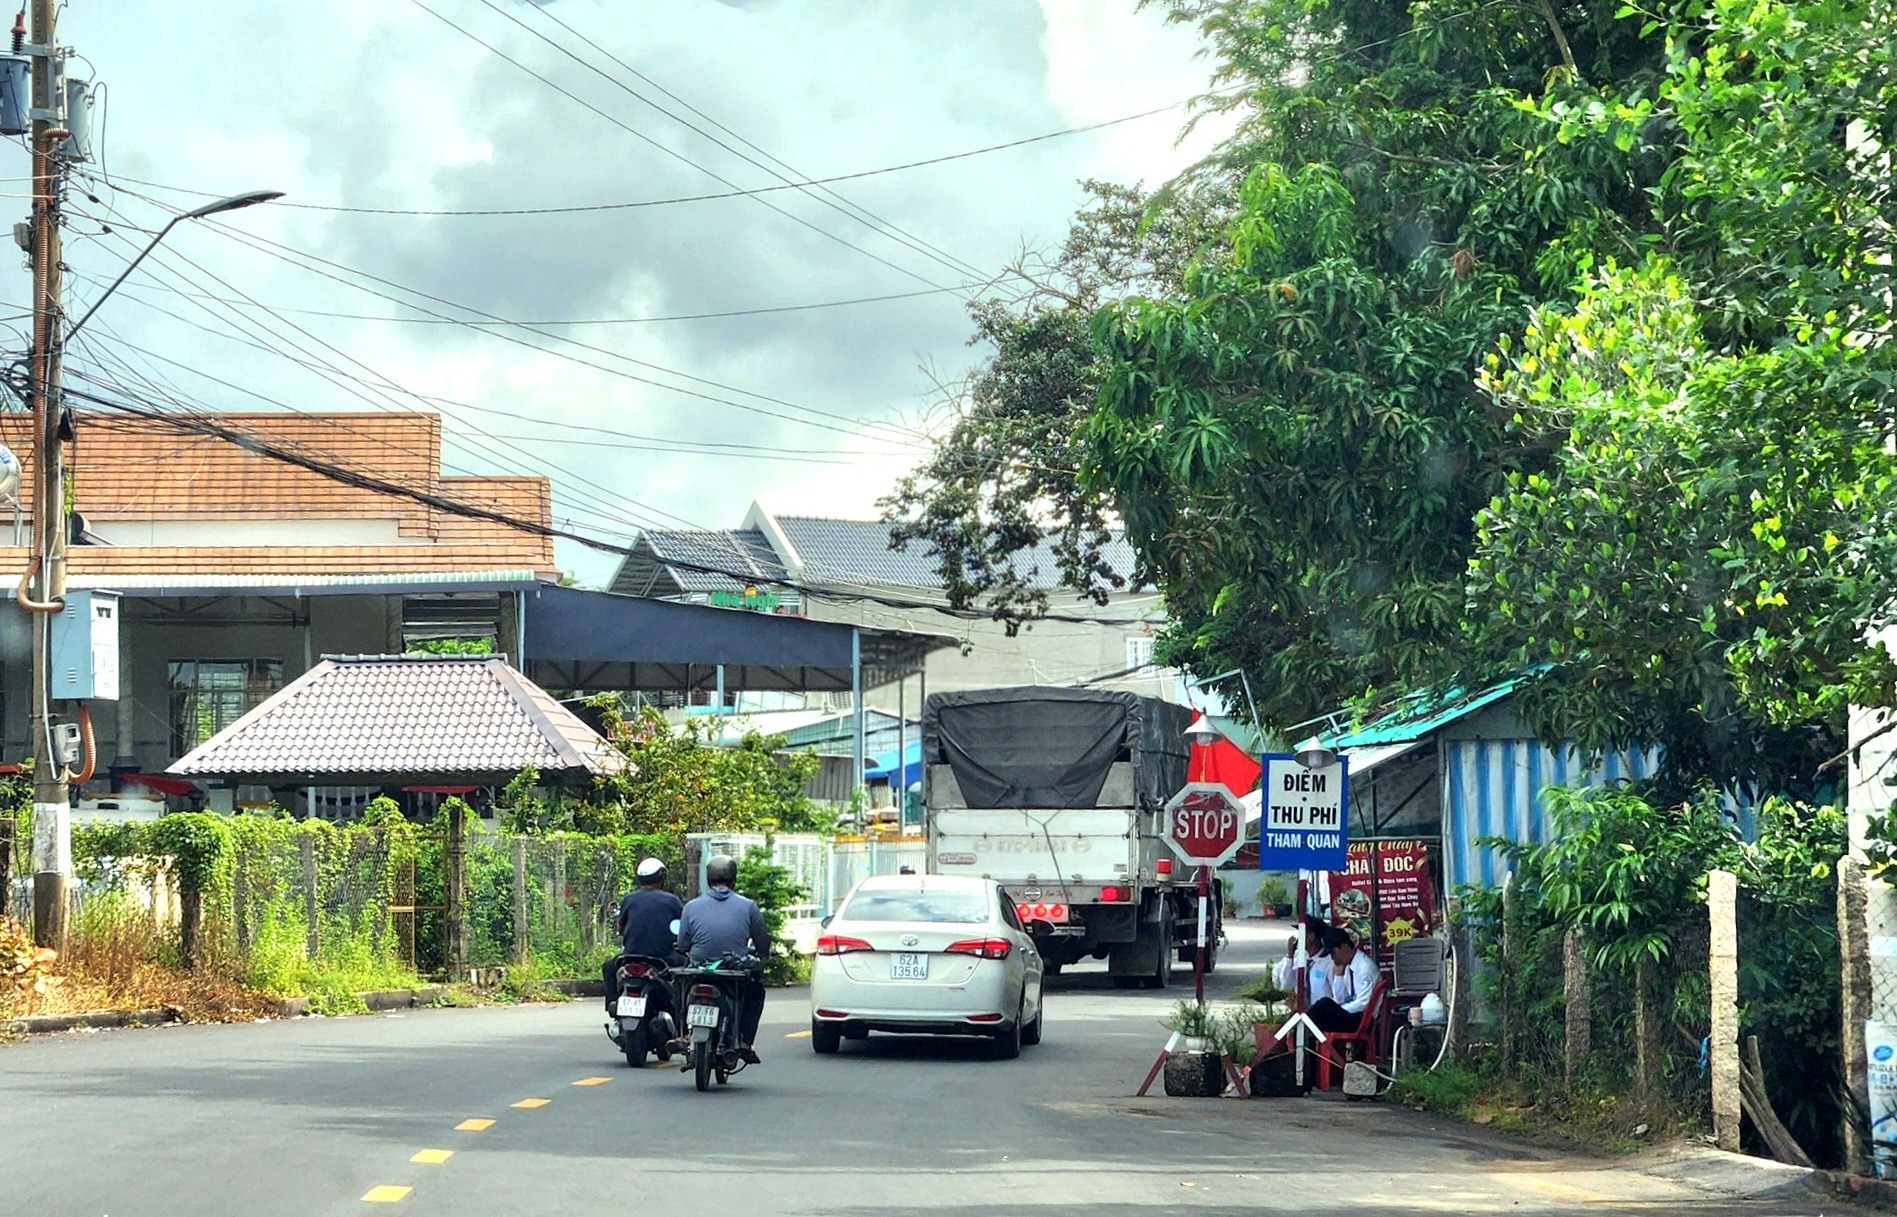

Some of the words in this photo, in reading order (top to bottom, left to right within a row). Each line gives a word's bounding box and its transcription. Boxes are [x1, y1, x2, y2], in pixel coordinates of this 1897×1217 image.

[1271, 805, 1304, 824] THU
[1309, 802, 1338, 825] PHÍ
[1177, 809, 1233, 840] STOP
[1267, 833, 1301, 848] THAM
[1307, 834, 1340, 851] QUAN
[1389, 927, 1412, 938] 39K
[900, 954, 919, 966] 62A
